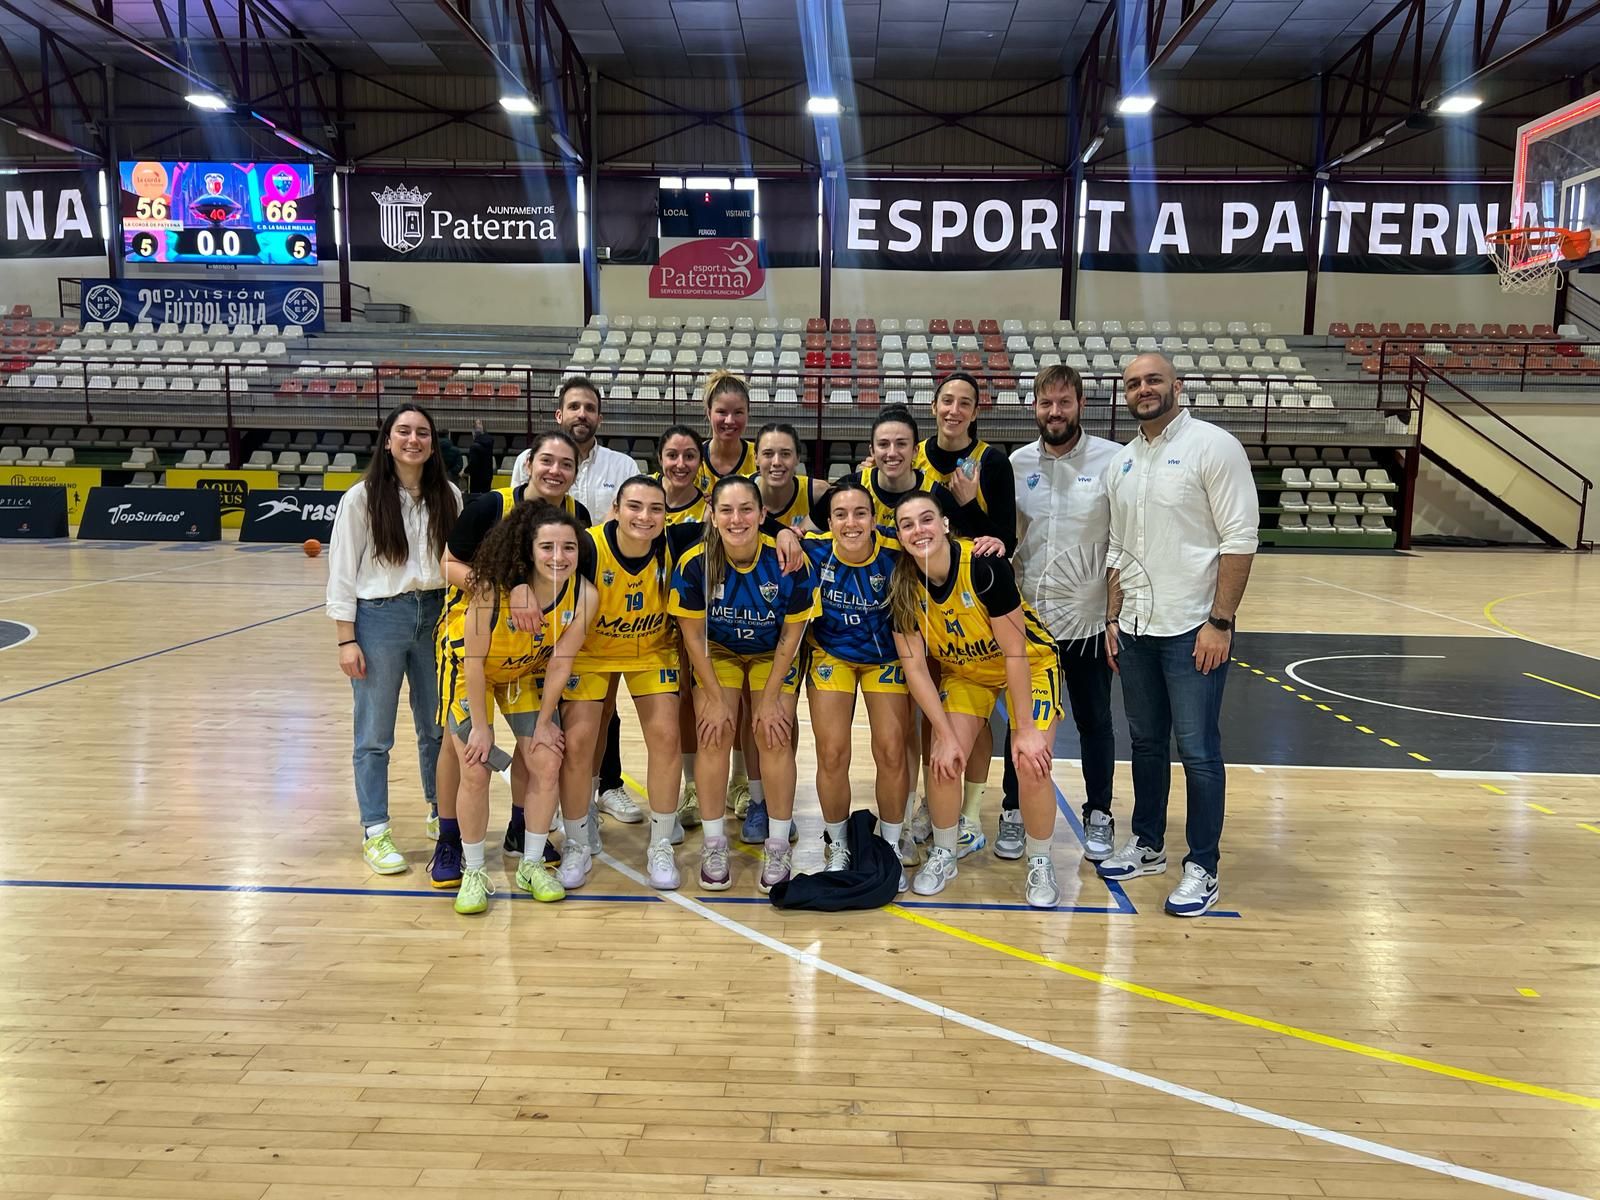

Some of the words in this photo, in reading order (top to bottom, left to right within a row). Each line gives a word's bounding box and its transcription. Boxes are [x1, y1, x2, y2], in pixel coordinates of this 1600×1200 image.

[6, 189, 93, 240] NA
[136, 197, 166, 220] 56
[266, 200, 298, 223] 66
[486, 205, 543, 215] AJUNTAMENT
[543, 205, 556, 214] DE
[663, 208, 689, 217] LOCAL
[725, 209, 751, 218] VISITANTE
[292, 224, 314, 232] MELILLA
[431, 210, 557, 241] Paterna
[1148, 202, 1190, 254] A
[140, 238, 152, 256] 5
[197, 230, 240, 257] 0.0
[293, 241, 305, 259] 5
[660, 267, 745, 288] Paterna
[693, 263, 721, 274] esport
[164, 288, 265, 300] DIVISIÓN
[713, 289, 745, 297] MUNICIPALS
[164, 298, 223, 325] FÚTBOL
[227, 301, 267, 325] SALA
[625, 592, 644, 612] 19
[822, 588, 880, 607] MELILLA
[711, 605, 776, 622] MELILLA
[841, 613, 861, 626] 10
[596, 612, 664, 634] Melilla
[734, 628, 755, 640] 12
[660, 669, 681, 684] 19
[783, 666, 797, 686] 2
[878, 664, 907, 684] 20
